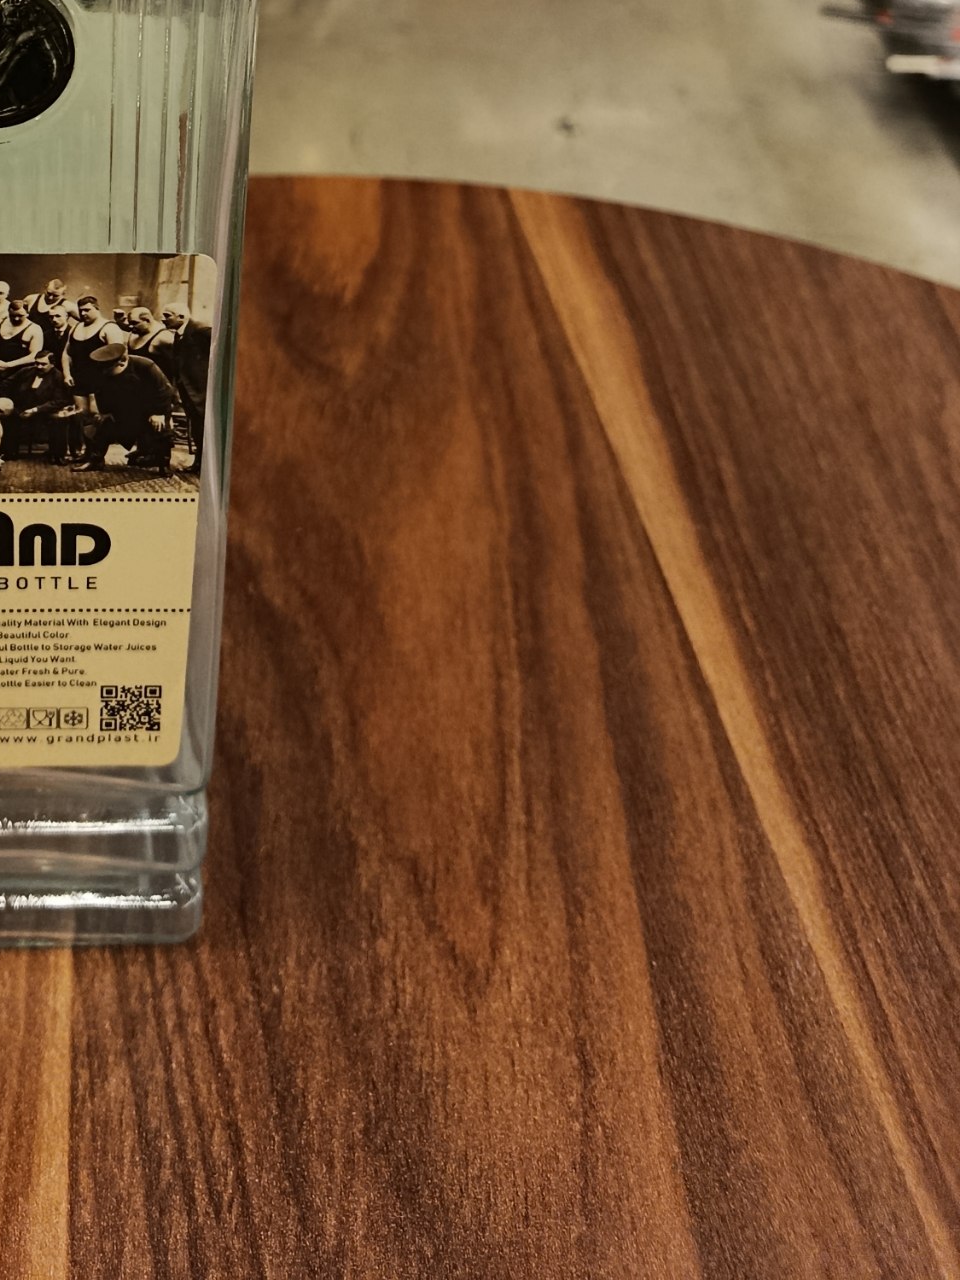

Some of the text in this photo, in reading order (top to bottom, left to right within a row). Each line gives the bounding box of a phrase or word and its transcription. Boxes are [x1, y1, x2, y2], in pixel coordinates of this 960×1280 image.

[24, 618, 65, 628] Material
[66, 618, 90, 627] With
[92, 618, 131, 629] Elegant
[132, 618, 168, 629] Design
[9, 643, 39, 652] Bottle
[40, 643, 51, 652] to
[52, 642, 92, 654] Storage
[93, 642, 123, 652] Water
[125, 642, 158, 652] Juices
[30, 655, 49, 664] You
[21, 667, 51, 676] Fresh
[52, 666, 60, 676] &
[24, 679, 56, 688] Easier
[57, 679, 68, 688] to
[68, 678, 98, 688] Clean
[0, 733, 161, 745] www.grandplast.ir
